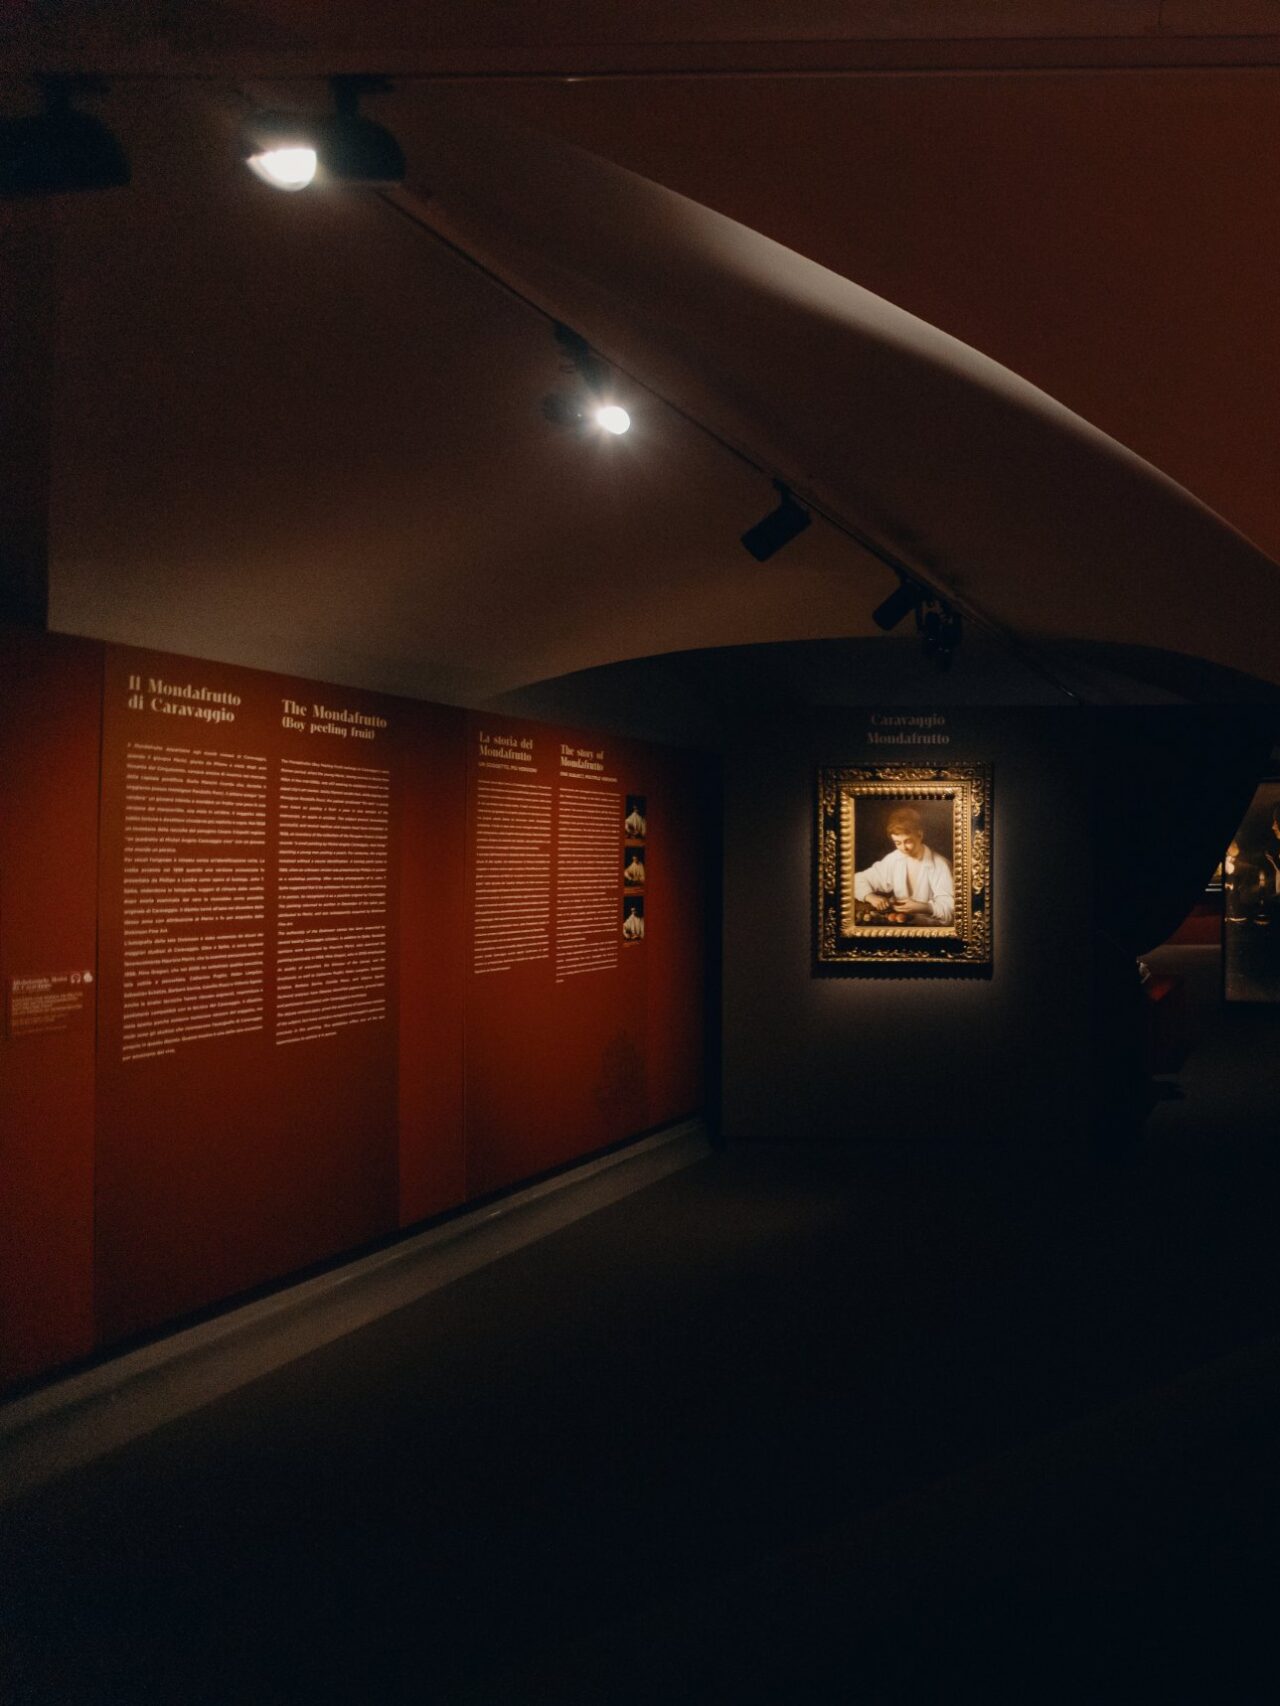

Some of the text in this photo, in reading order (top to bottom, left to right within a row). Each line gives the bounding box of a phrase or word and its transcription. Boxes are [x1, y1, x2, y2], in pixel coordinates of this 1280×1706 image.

[129, 674, 242, 707] Il Mondafrutto
[128, 694, 236, 724] di Caravaggio
[281, 698, 388, 729] The Mondafrutto
[870, 713, 945, 728] Caravaggio
[310, 722, 348, 739] peeling
[866, 731, 951, 745] Mondafrutto
[520, 738, 533, 750] del
